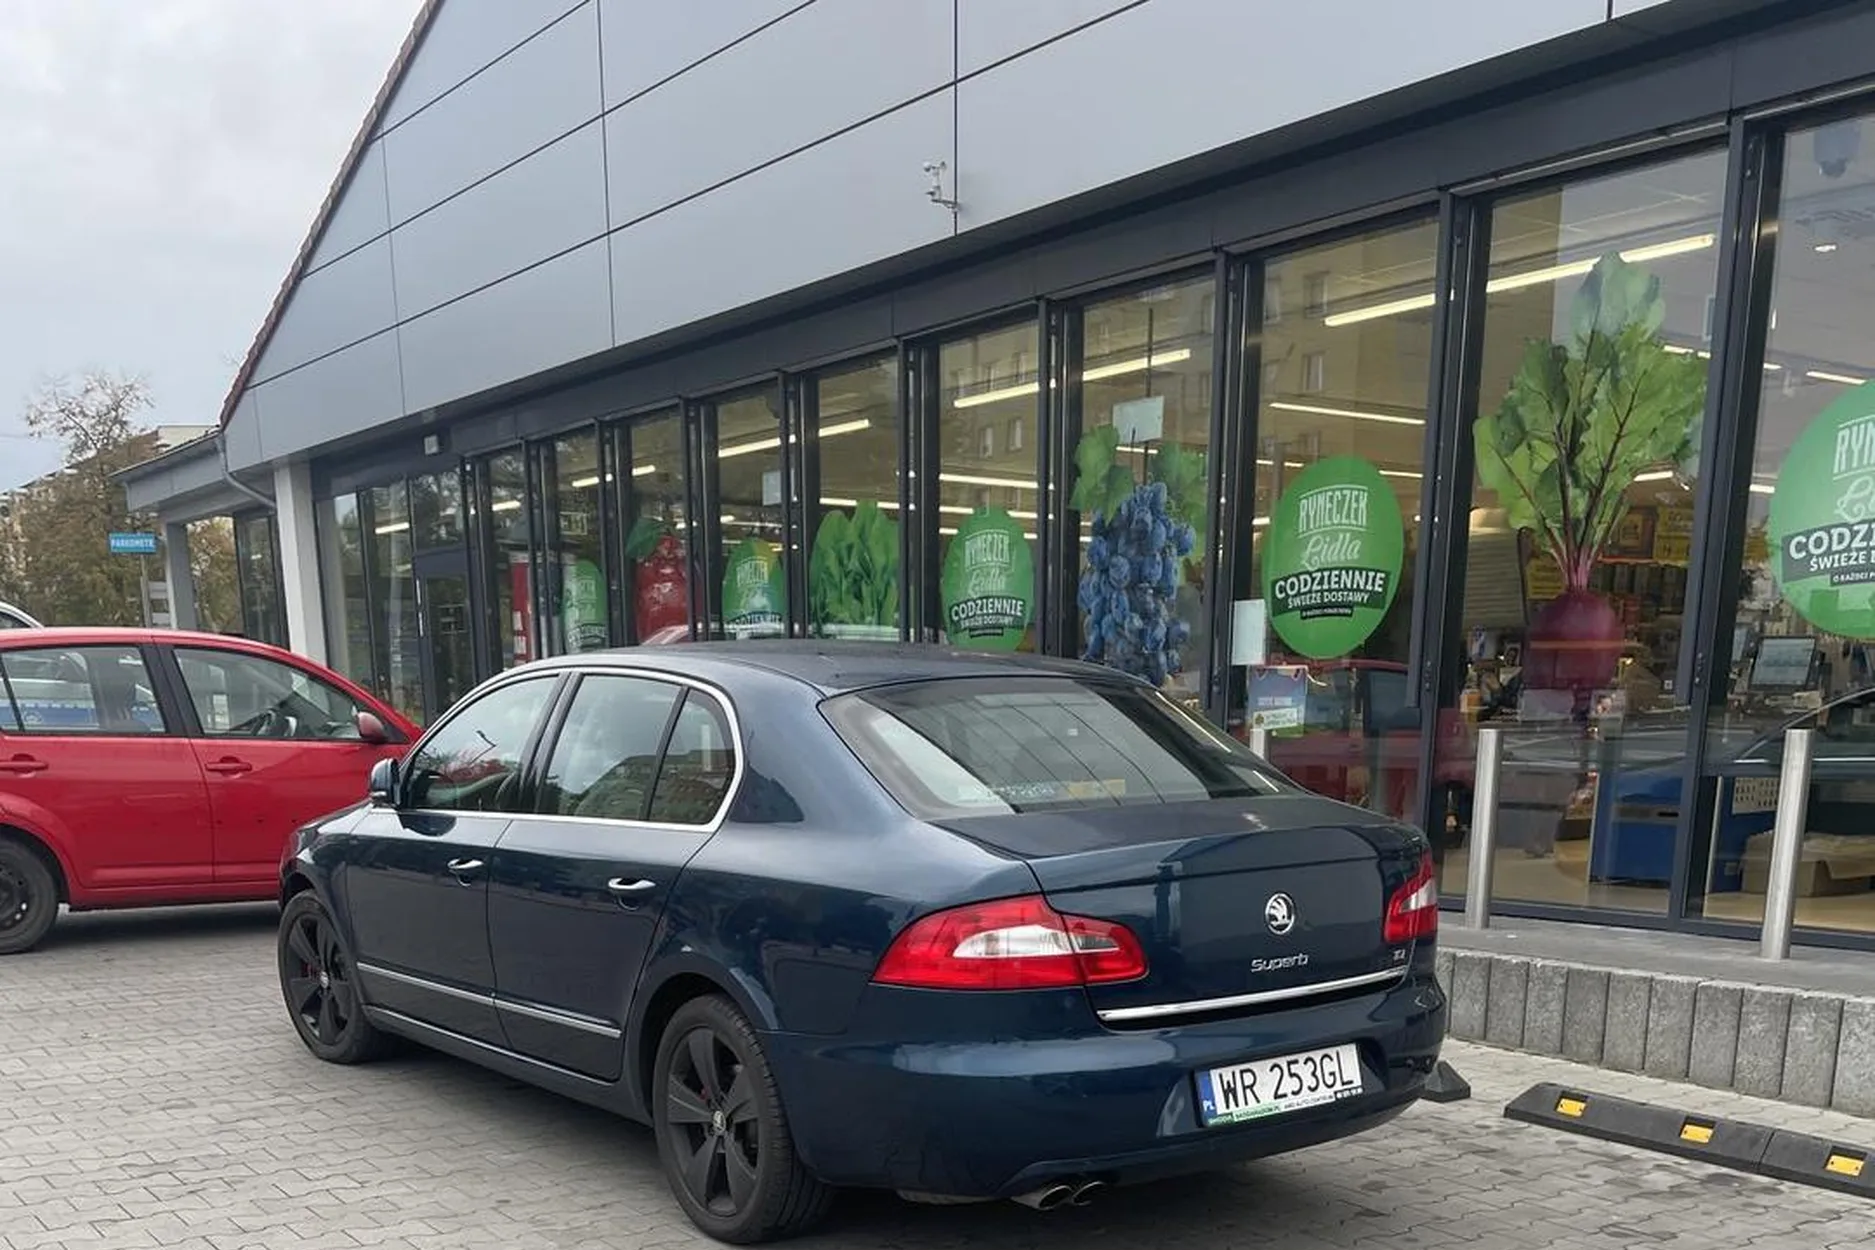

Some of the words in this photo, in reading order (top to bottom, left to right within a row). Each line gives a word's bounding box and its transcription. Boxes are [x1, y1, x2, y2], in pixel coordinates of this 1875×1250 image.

[1299, 489, 1368, 532] RYNECZEK
[1302, 531, 1362, 571] Lidla
[1275, 569, 1386, 600] CODZIENNIE
[1324, 590, 1370, 604] DOSTAWY
[951, 598, 1024, 620] CODZIENNIE
[1251, 953, 1309, 973] Superb
[1219, 1068, 1261, 1110] WR
[1269, 1050, 1354, 1101] 253GL
[1203, 1100, 1215, 1112] PL
